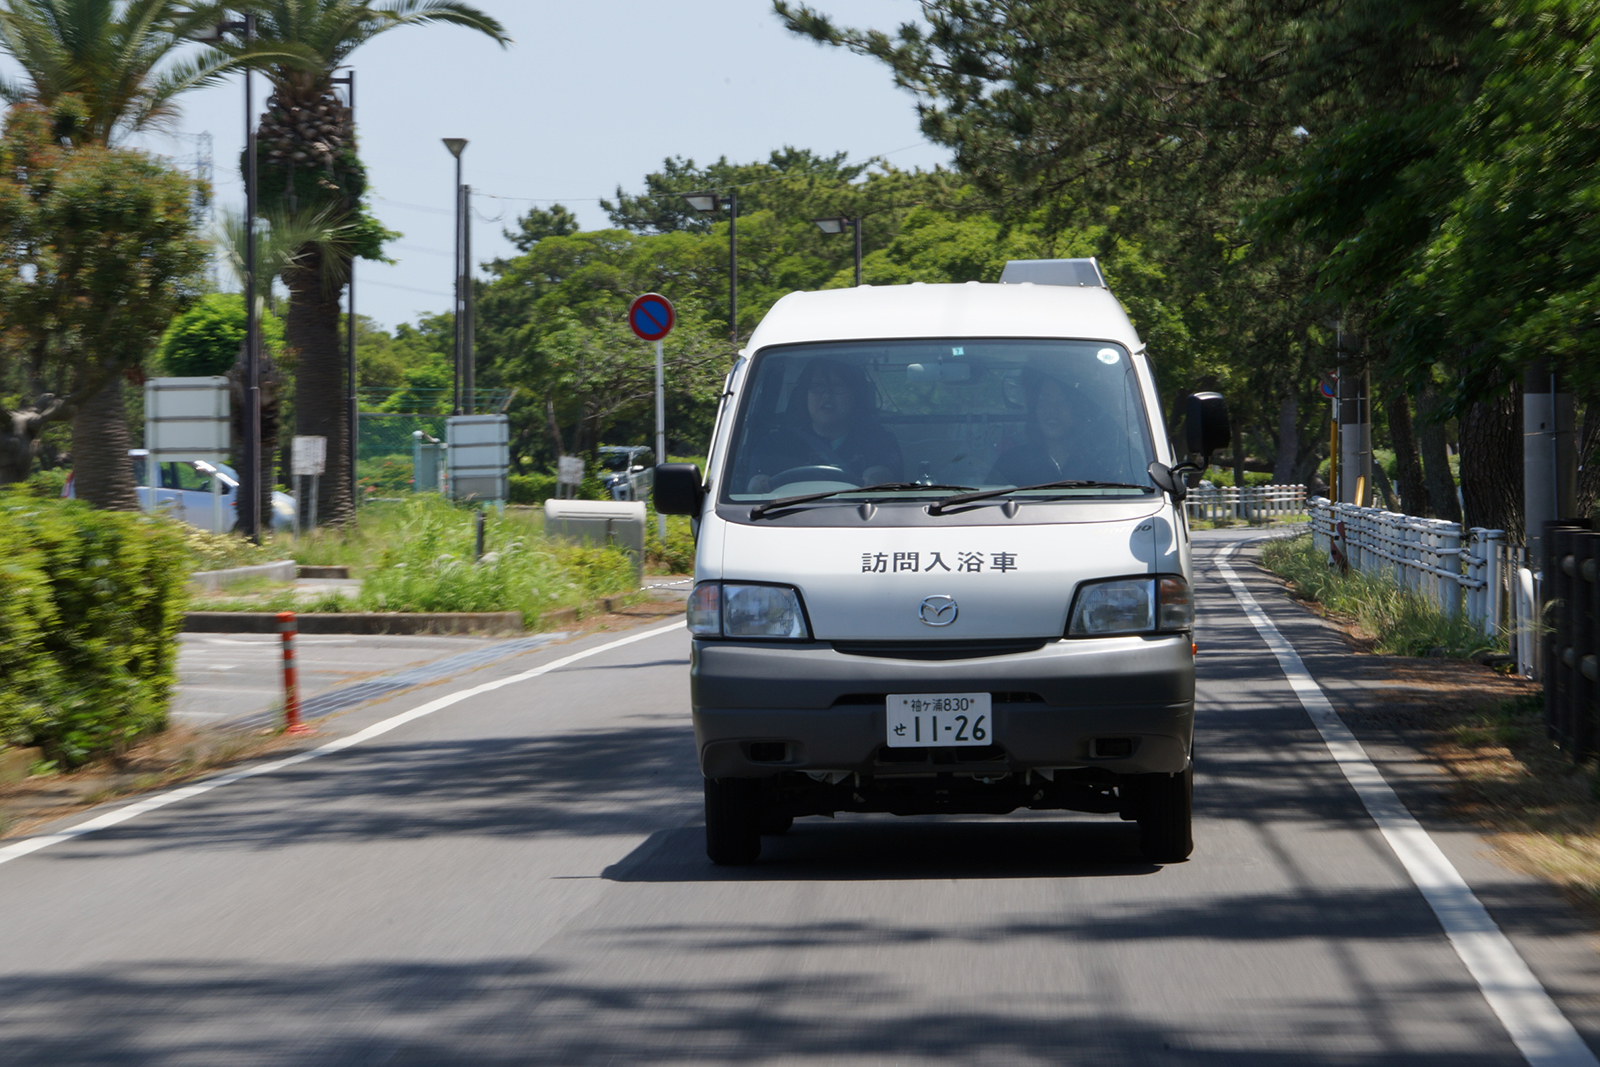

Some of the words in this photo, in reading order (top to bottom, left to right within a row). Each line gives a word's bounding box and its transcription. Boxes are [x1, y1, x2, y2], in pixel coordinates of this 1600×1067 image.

[861, 551, 1018, 573] 訪問入浴車
[893, 723, 907, 736] せ
[915, 715, 986, 742] 11-26
